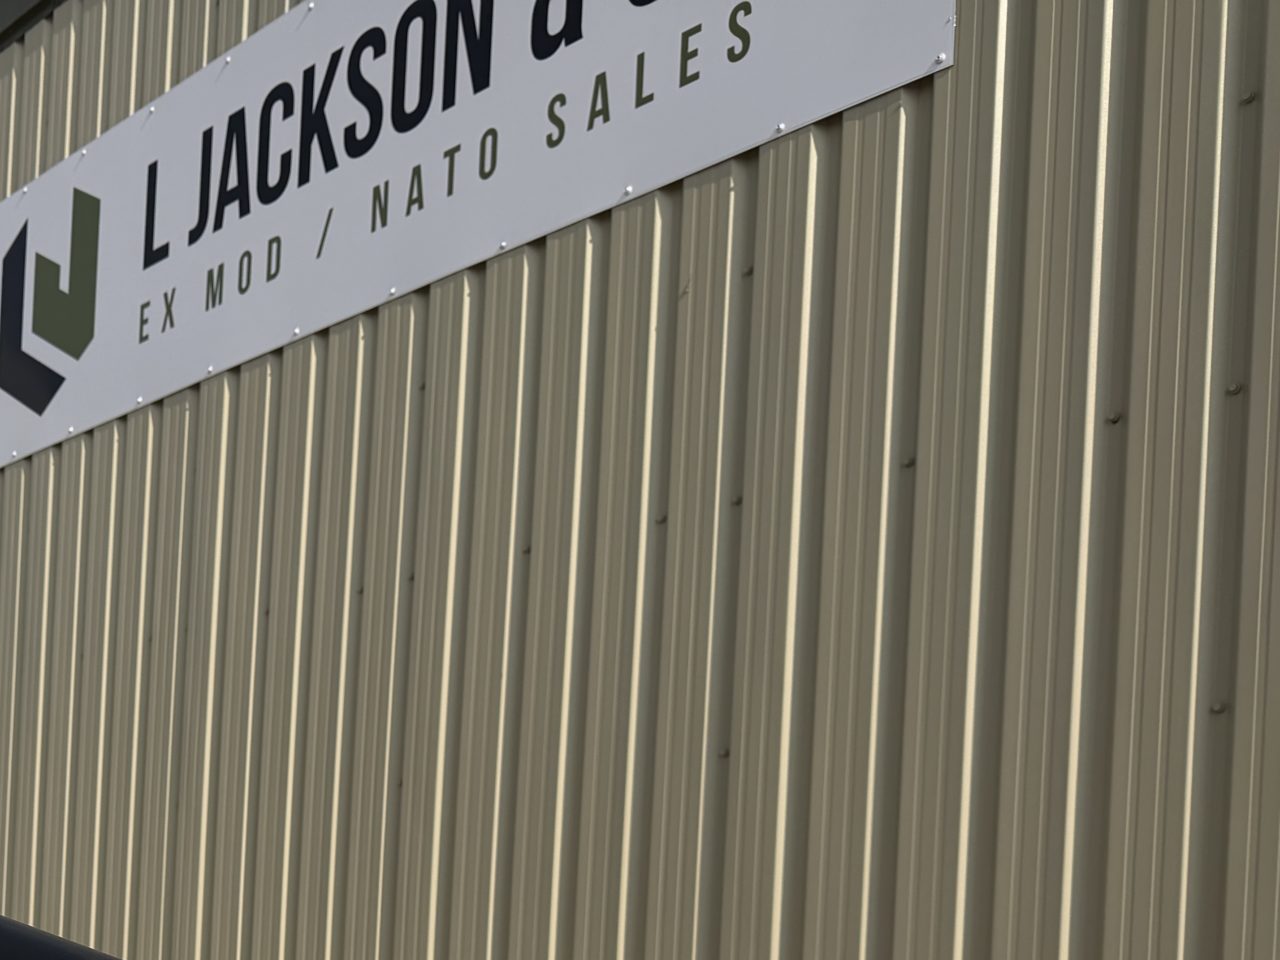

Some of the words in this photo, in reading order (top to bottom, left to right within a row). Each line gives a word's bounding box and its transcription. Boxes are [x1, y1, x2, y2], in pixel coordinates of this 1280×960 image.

[139, 287, 176, 344] EX
[205, 235, 281, 312] MOD
[316, 207, 333, 259] /
[371, 127, 498, 233] NATO
[546, 0, 752, 149] SALES
[143, 160, 170, 270] L
[188, 0, 494, 247] JACKSON
